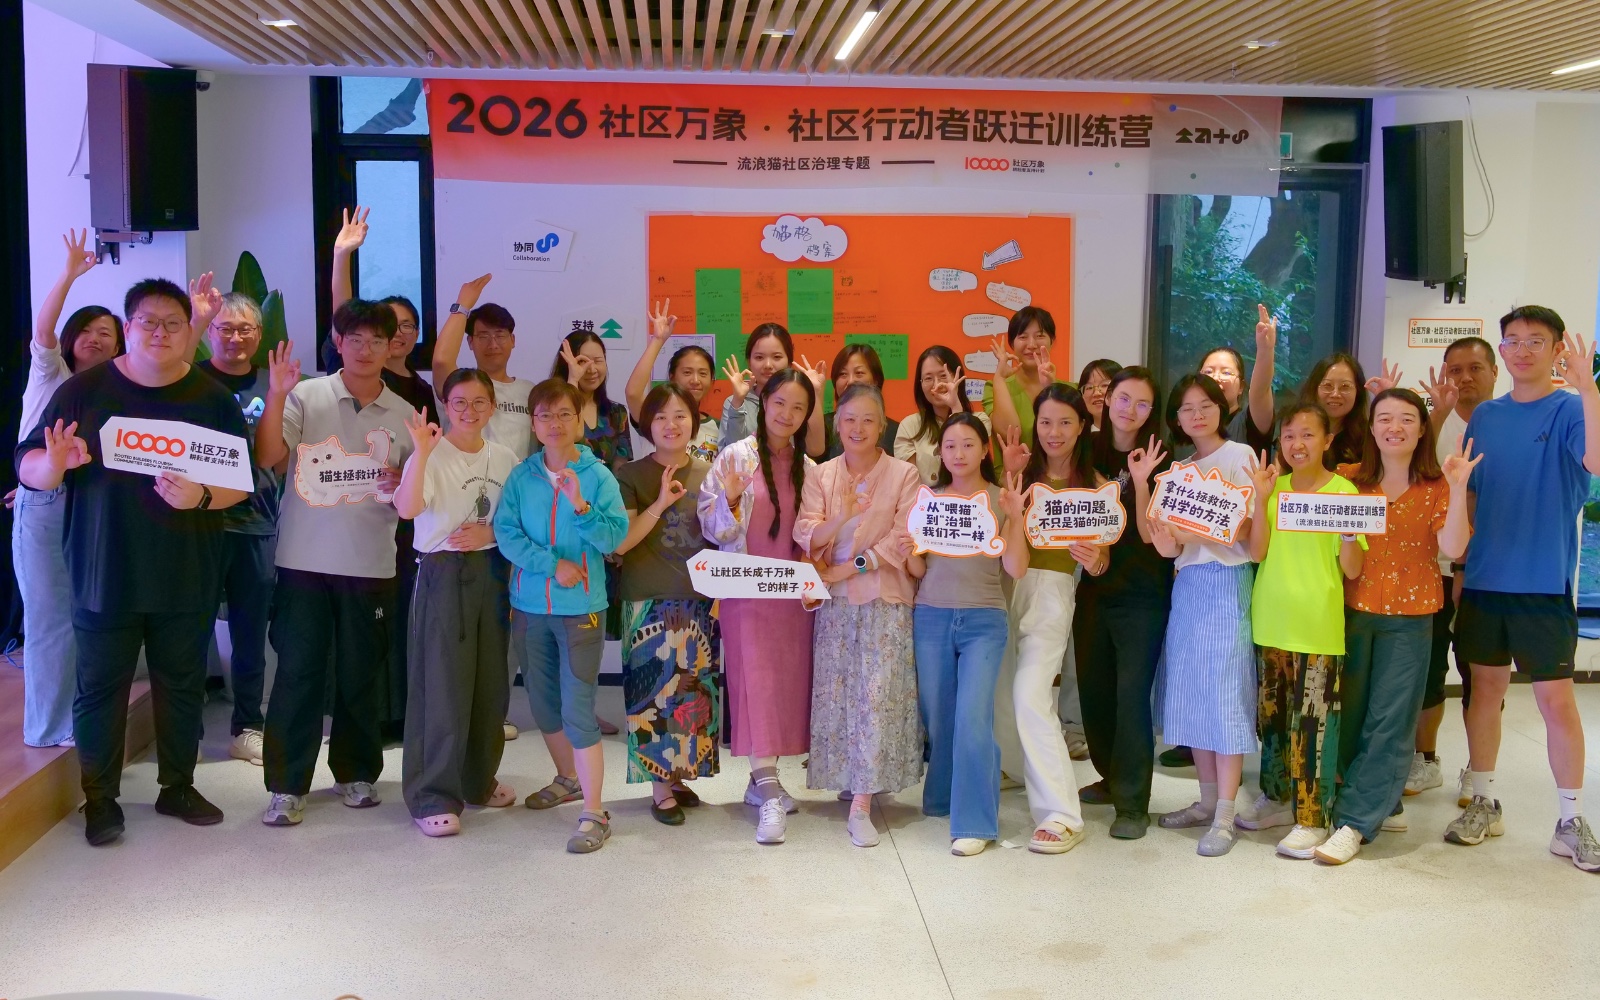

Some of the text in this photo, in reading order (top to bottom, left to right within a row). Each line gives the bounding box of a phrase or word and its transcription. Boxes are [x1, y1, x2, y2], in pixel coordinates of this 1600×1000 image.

[447, 92, 587, 139] 2026
[737, 156, 870, 172] 流浪猫社区治理专题
[965, 157, 1009, 171] 10000
[1012, 159, 1044, 168] 社区万象
[513, 242, 534, 253] 协同
[572, 320, 594, 331] 支持
[116, 428, 186, 457] 10000
[190, 441, 240, 460] 社区万象
[1160, 495, 1231, 528] 科学的方法
[1038, 514, 1119, 529] 不只是猫的问题
[922, 526, 985, 542] 我们不一样
